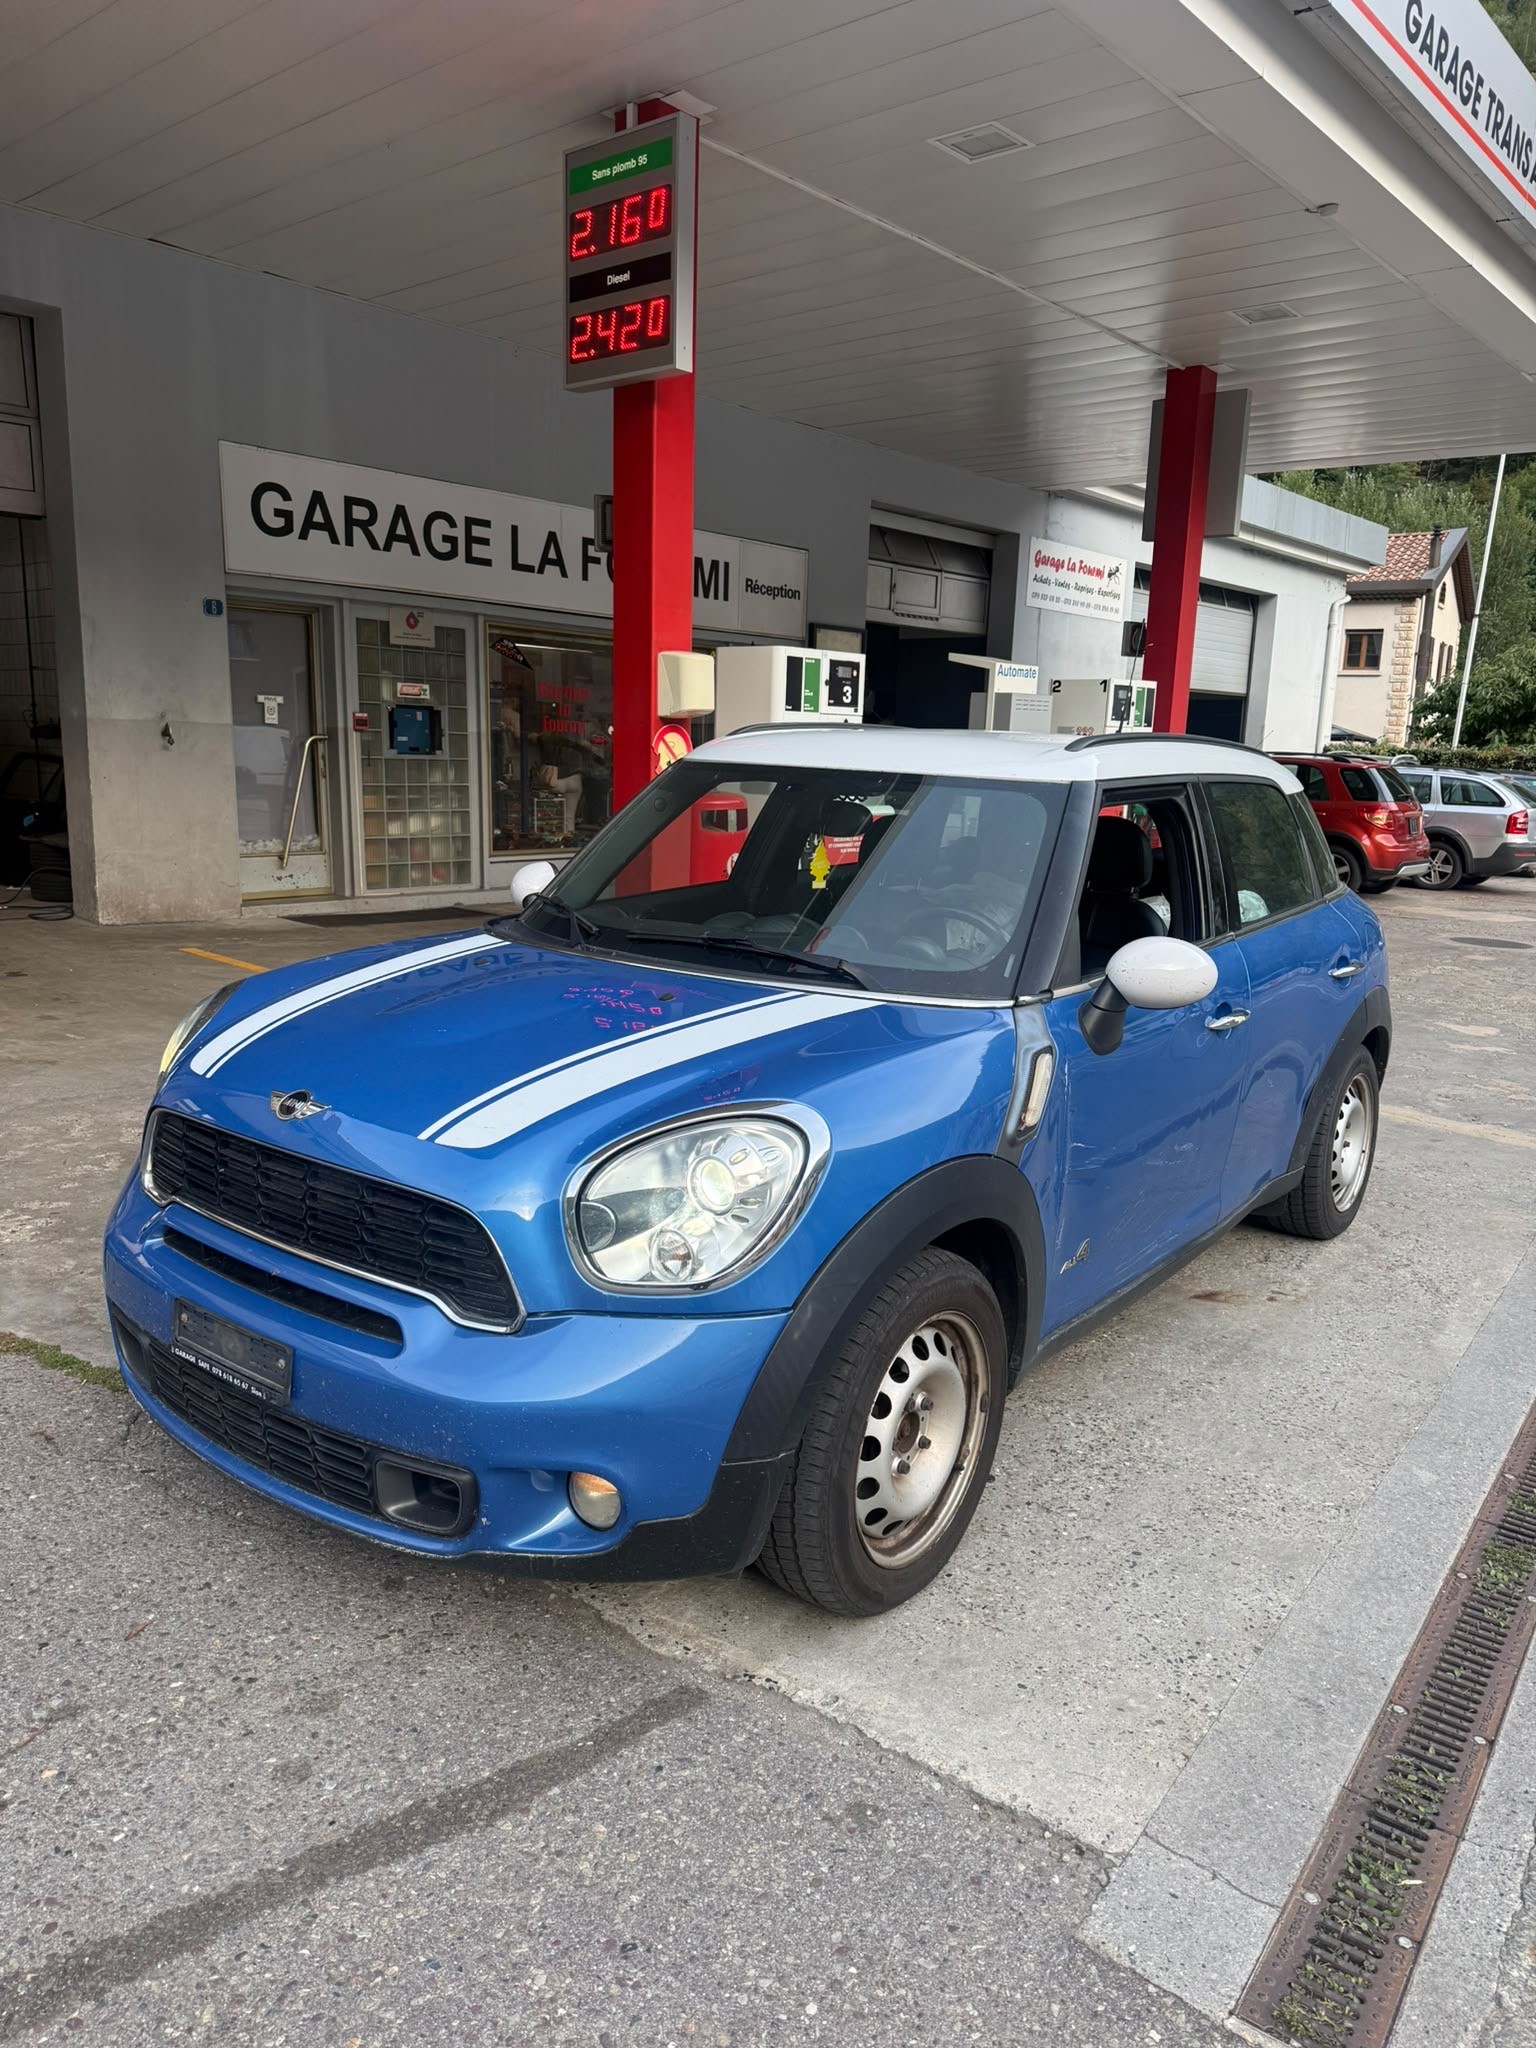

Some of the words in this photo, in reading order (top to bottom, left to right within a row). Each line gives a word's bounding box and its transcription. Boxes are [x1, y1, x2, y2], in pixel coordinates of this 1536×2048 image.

[1405, 0, 1485, 120] GARAGE
[592, 169, 611, 180] Sans
[612, 158, 637, 177] plomb
[637, 153, 648, 166] 95
[571, 187, 667, 259] 2.160
[606, 271, 631, 286] Diesel
[571, 298, 666, 360] 2.420
[250, 481, 493, 567] GARAGE
[511, 524, 569, 579] LA
[1034, 550, 1065, 573] Garage
[1066, 557, 1077, 573] La
[1077, 560, 1106, 580] Fourmi
[1032, 573, 1052, 586] Achats
[745, 578, 801, 600] Réception
[211, 601, 218, 614] 6
[997, 664, 1037, 680] Automate
[842, 685, 852, 703] 3
[1052, 680, 1062, 693] 2
[1100, 679, 1108, 692] 1
[175, 1348, 196, 1363] GARAGE
